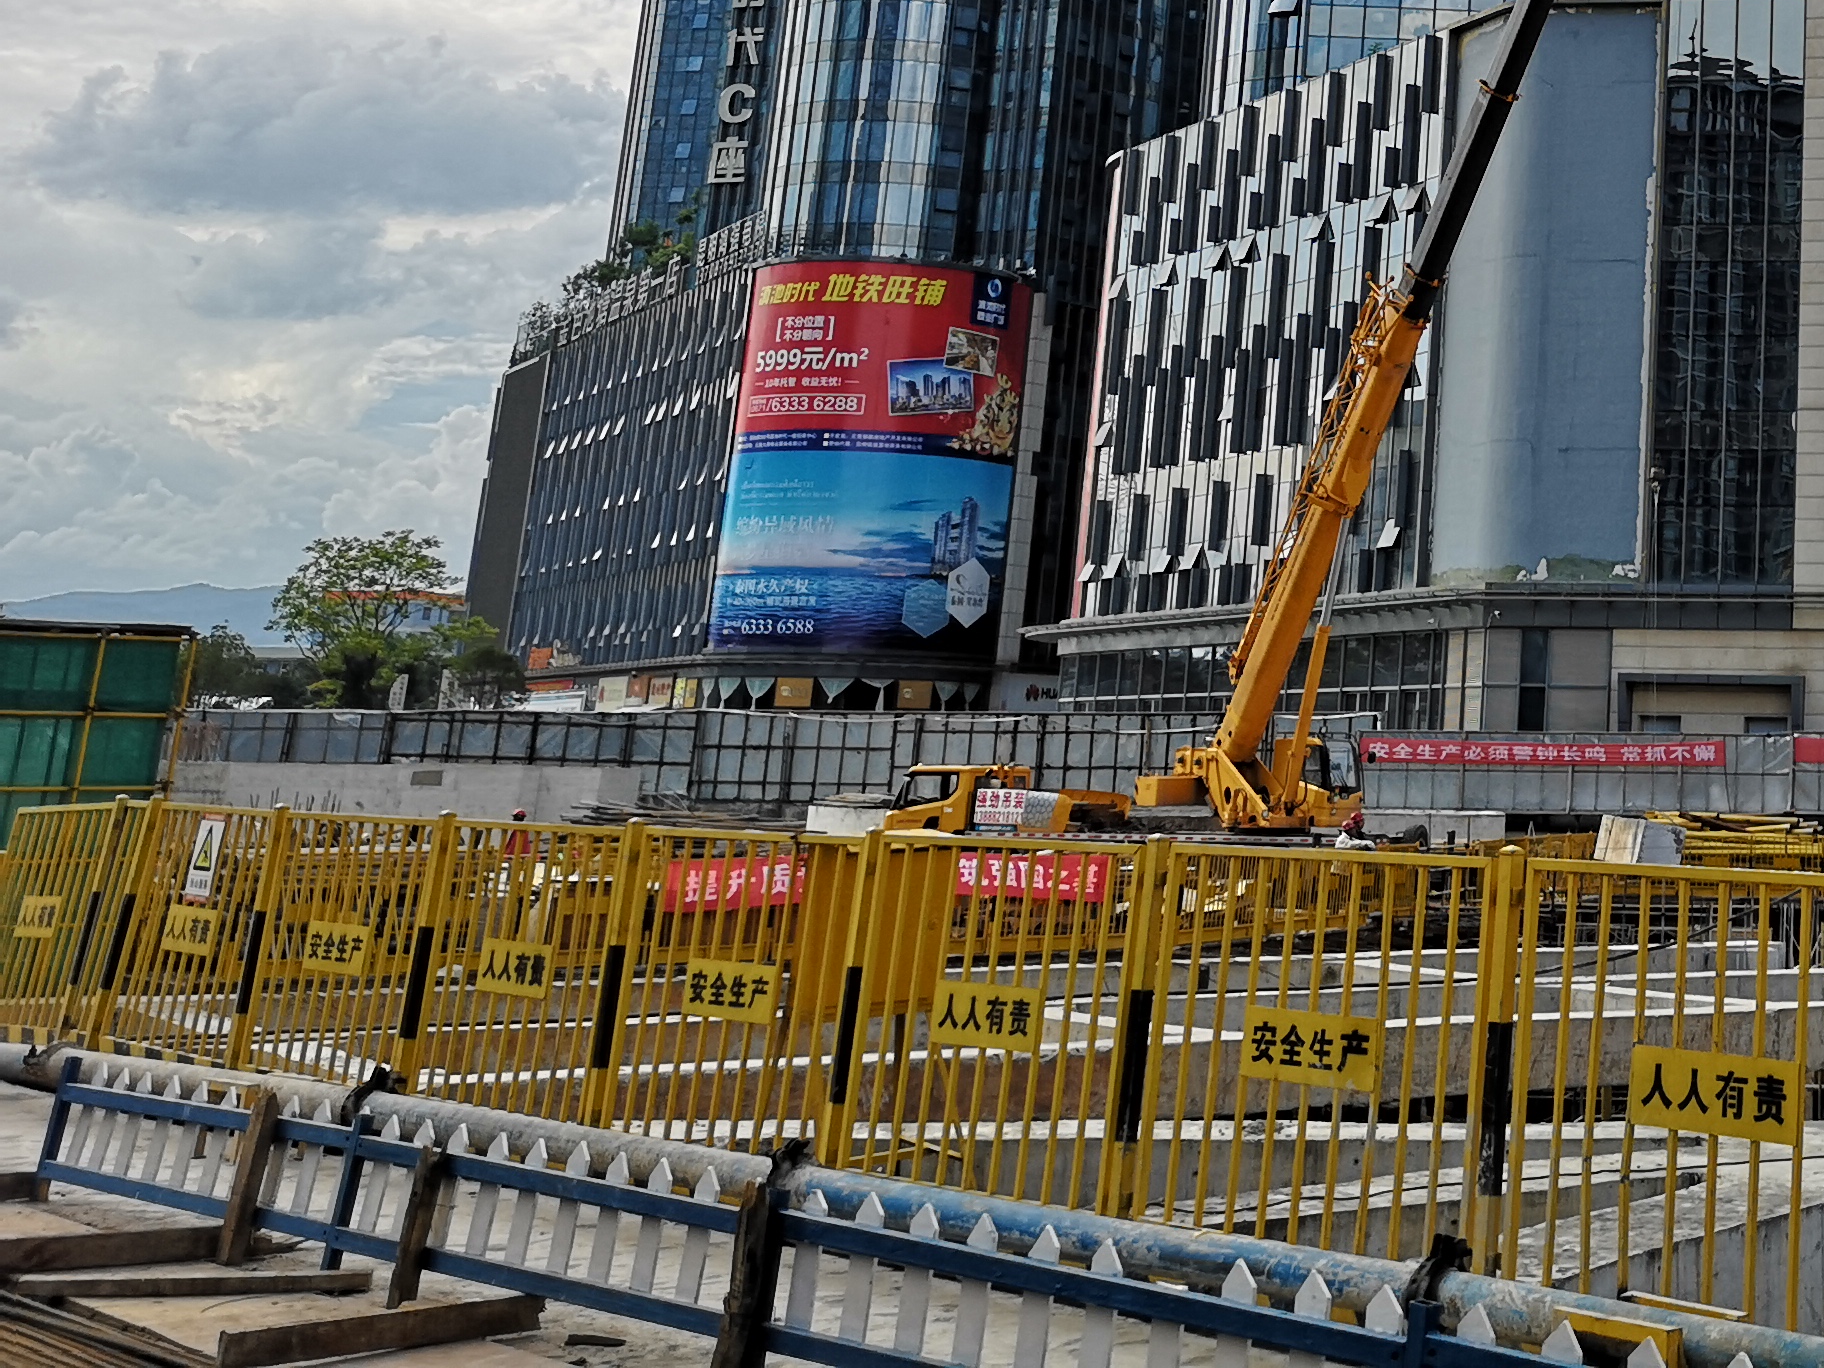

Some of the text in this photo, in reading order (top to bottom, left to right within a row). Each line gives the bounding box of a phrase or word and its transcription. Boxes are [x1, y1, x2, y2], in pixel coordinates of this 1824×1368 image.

[758, 273, 947, 306] 滇池时代 地铁旺铺
[813, 396, 858, 411] 6288
[741, 618, 773, 635] 6333
[776, 618, 815, 635] 6588
[1369, 741, 1716, 763] 安全生产必须警钟长鸣 常抓不懈
[685, 862, 806, 902] 提升质
[166, 915, 212, 946] 人人有责
[306, 930, 364, 964] 安全生产
[482, 950, 546, 987] 人人有责
[689, 970, 769, 1016] 安全生产
[938, 993, 1031, 1037] 人人有责
[1252, 1021, 1370, 1073] 安全生产
[1640, 1063, 1787, 1126] 人人有责
